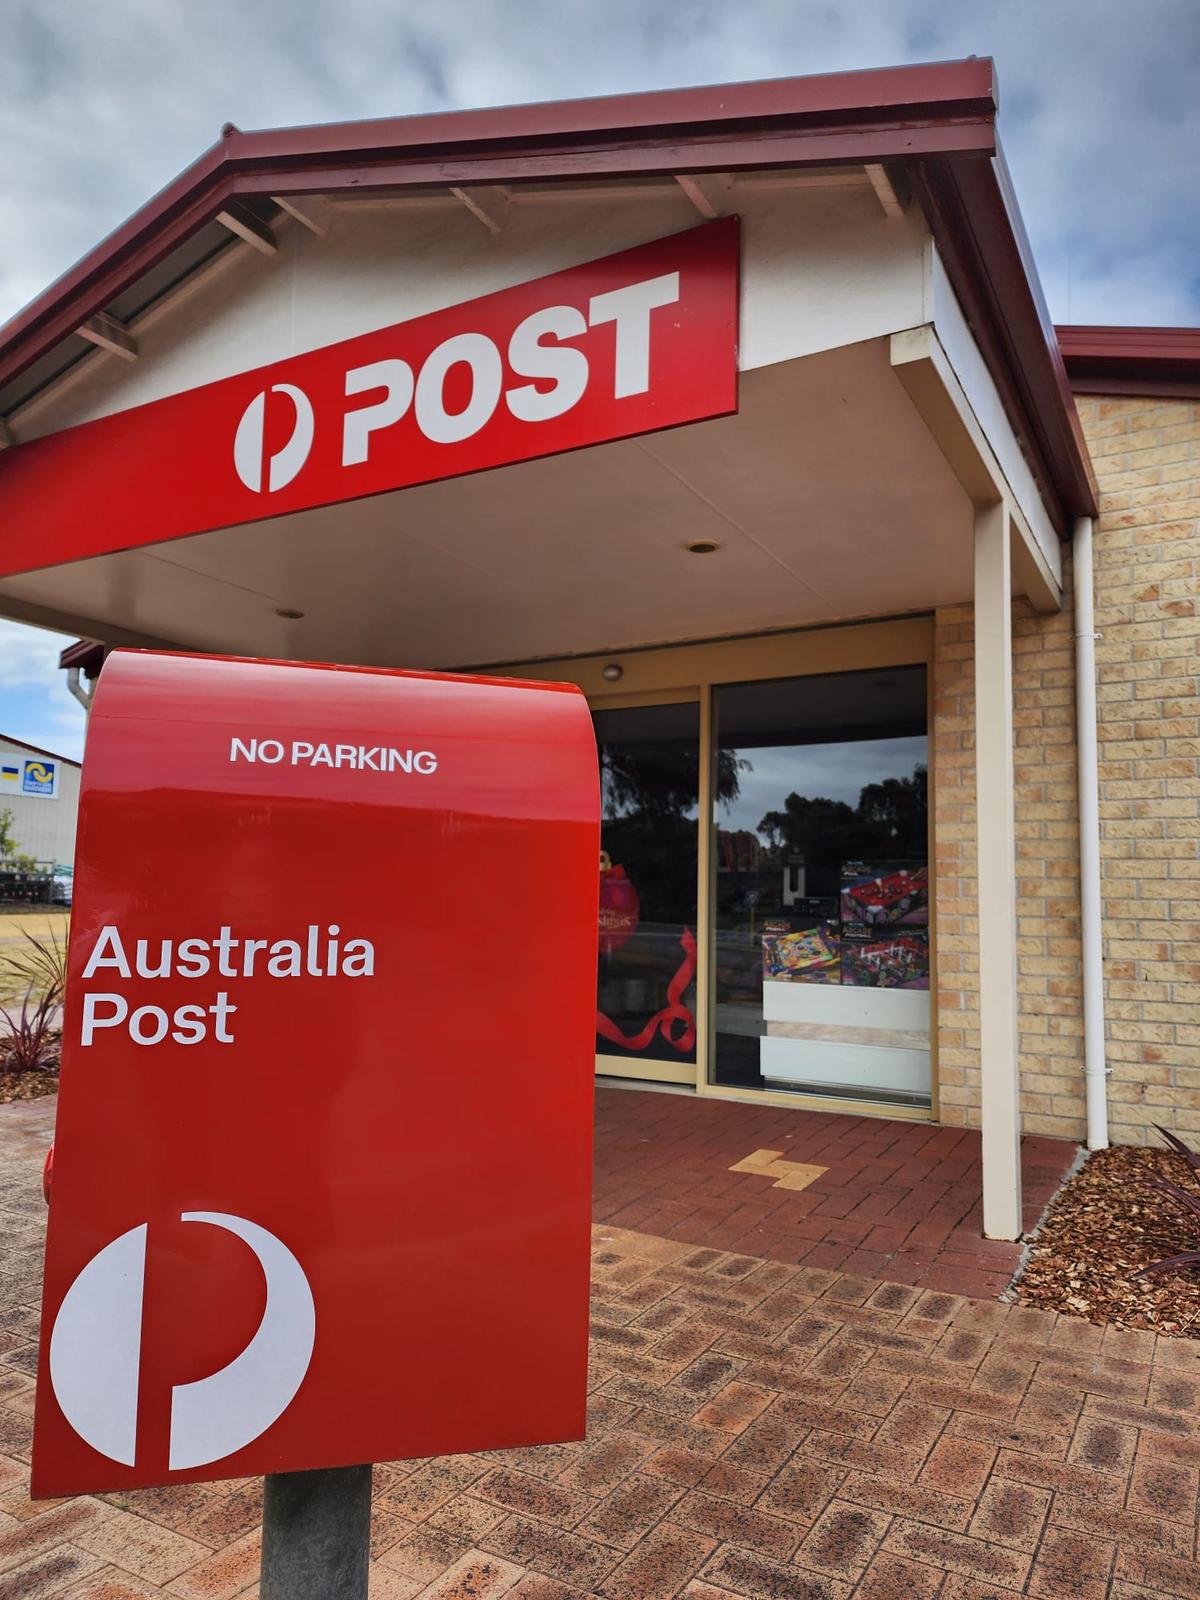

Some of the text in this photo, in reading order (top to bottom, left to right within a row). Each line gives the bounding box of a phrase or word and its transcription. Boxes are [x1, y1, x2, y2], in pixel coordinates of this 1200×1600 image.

[342, 271, 680, 467] POST
[229, 737, 438, 777] NO PARKING
[80, 924, 376, 979] Australia
[79, 990, 239, 1047] Post
